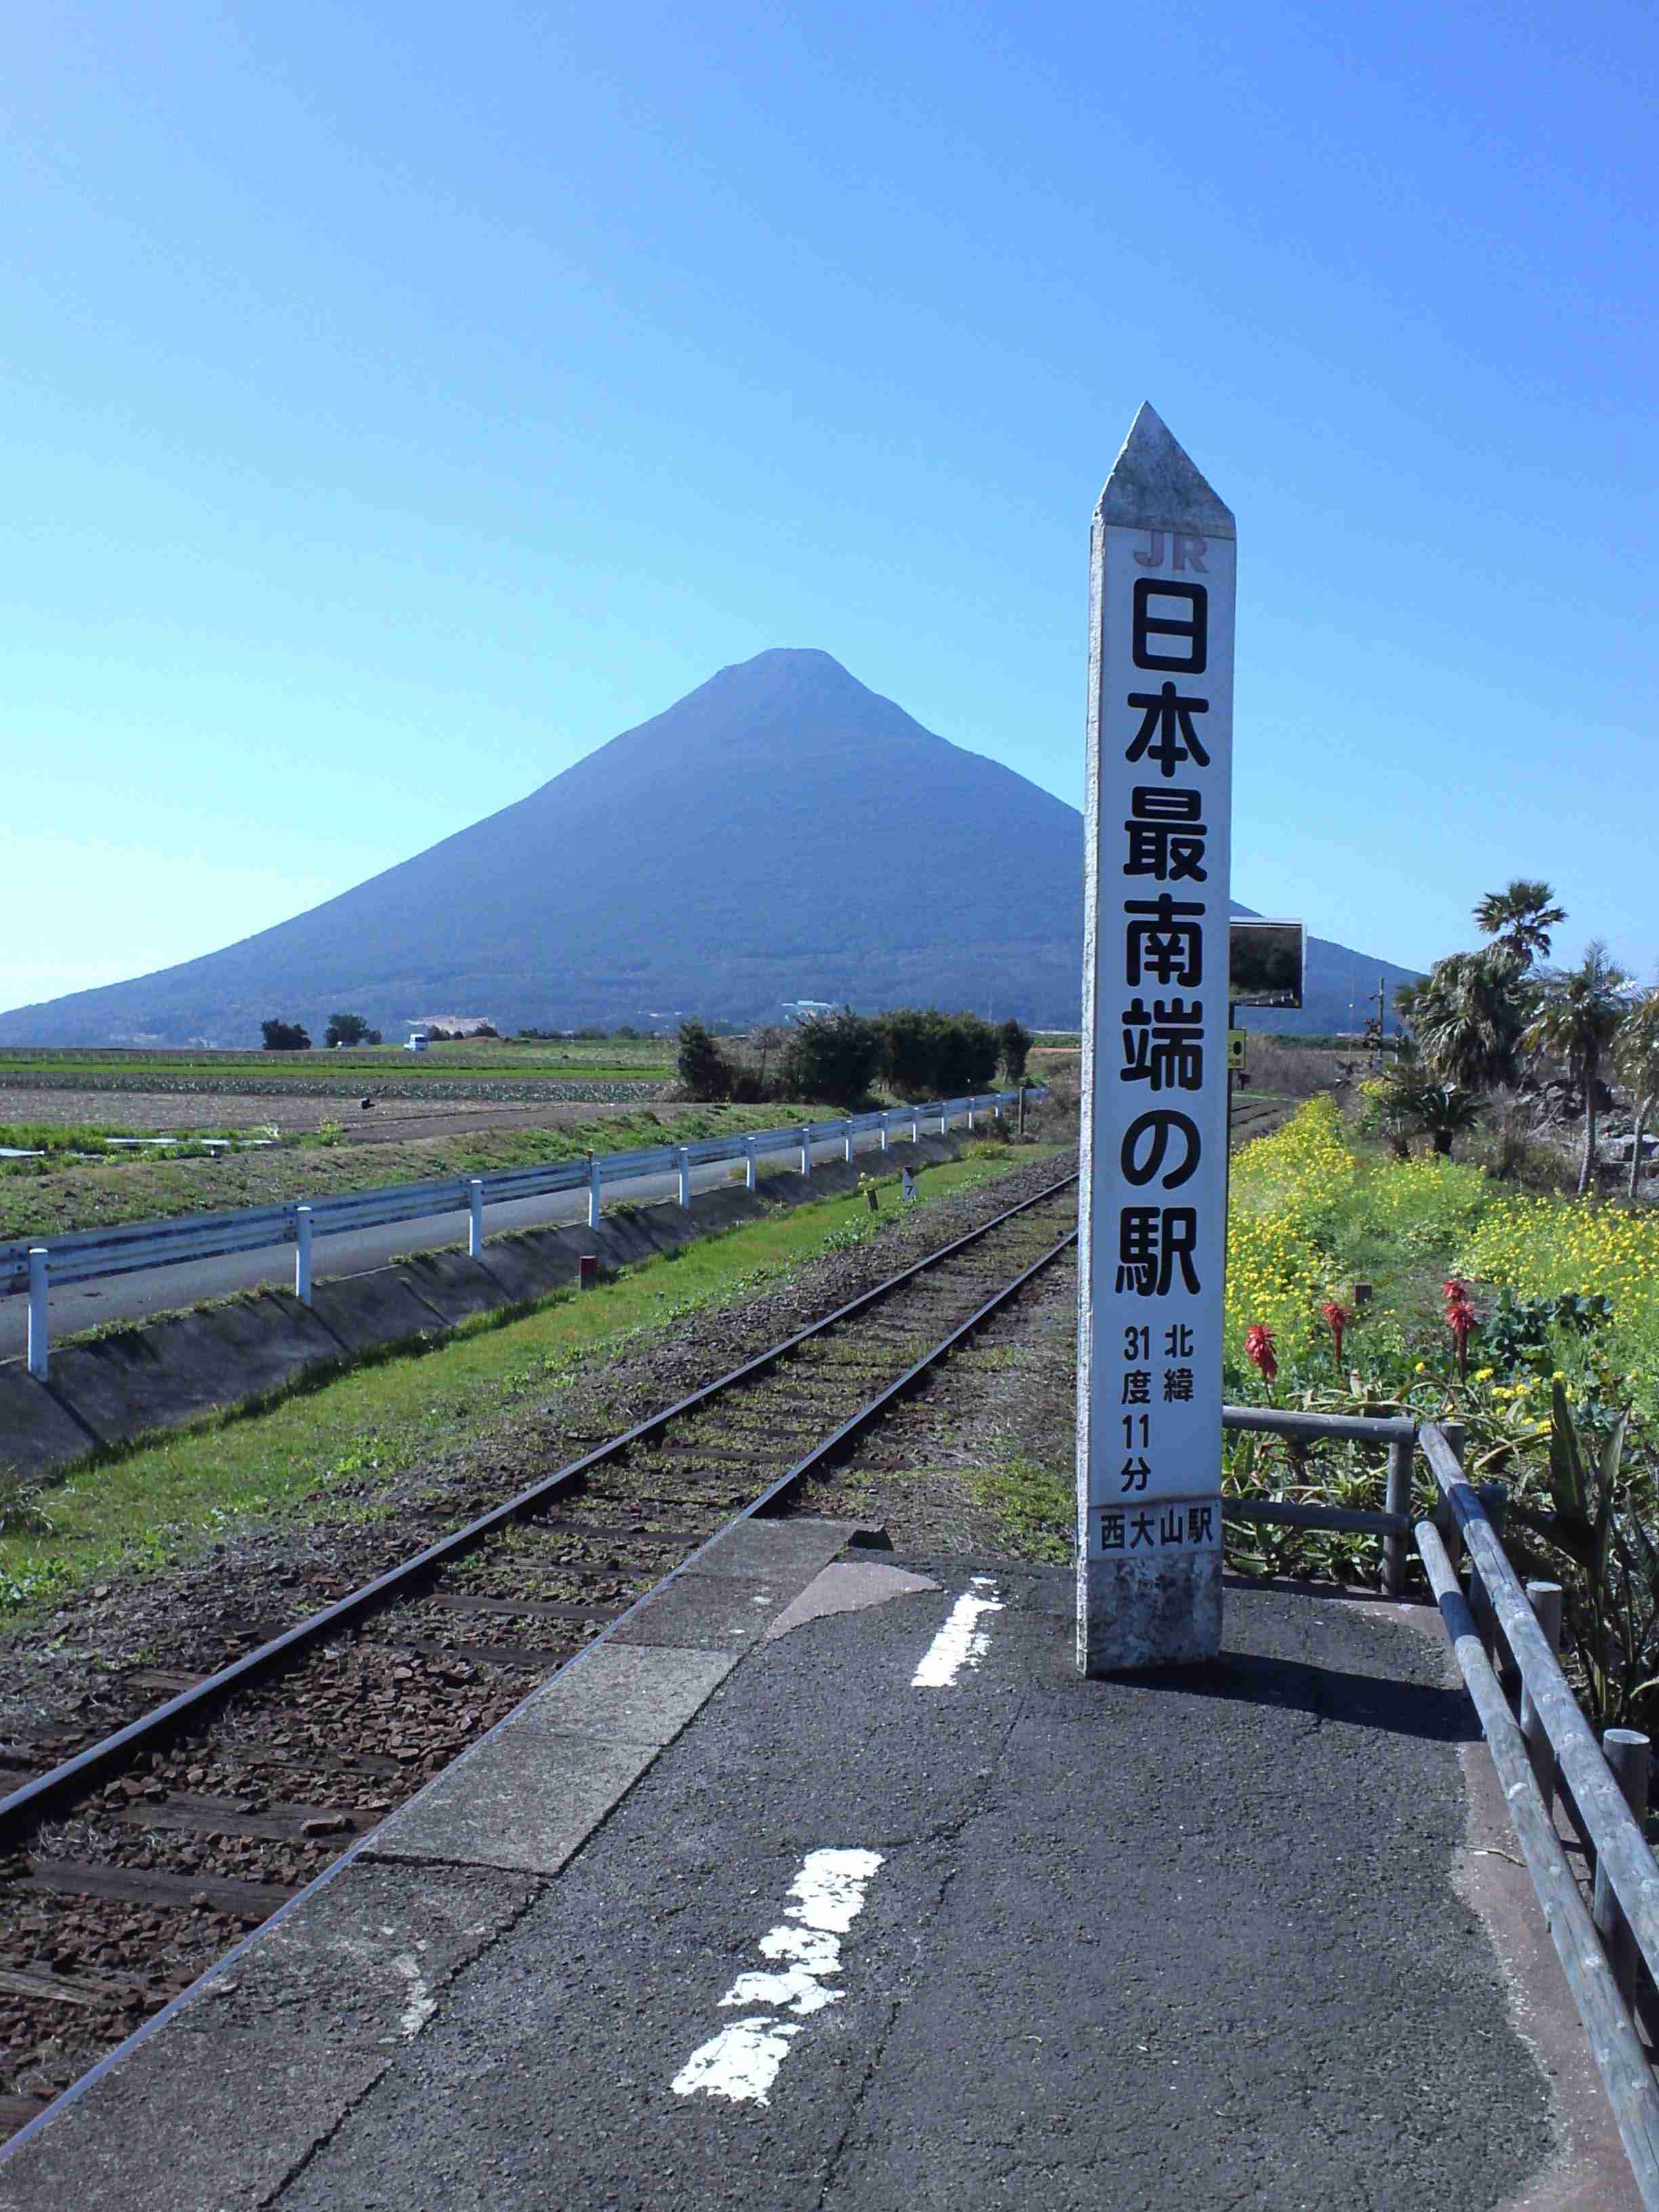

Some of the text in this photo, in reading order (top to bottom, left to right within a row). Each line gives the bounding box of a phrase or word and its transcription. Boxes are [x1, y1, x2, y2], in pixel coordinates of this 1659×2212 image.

[1132, 530, 1209, 573] JR
[1115, 577, 1211, 1296] 日本最南端の駅
[1164, 1323, 1194, 1403] 北緯
[1101, 1507, 1214, 1551] 西大山駅
